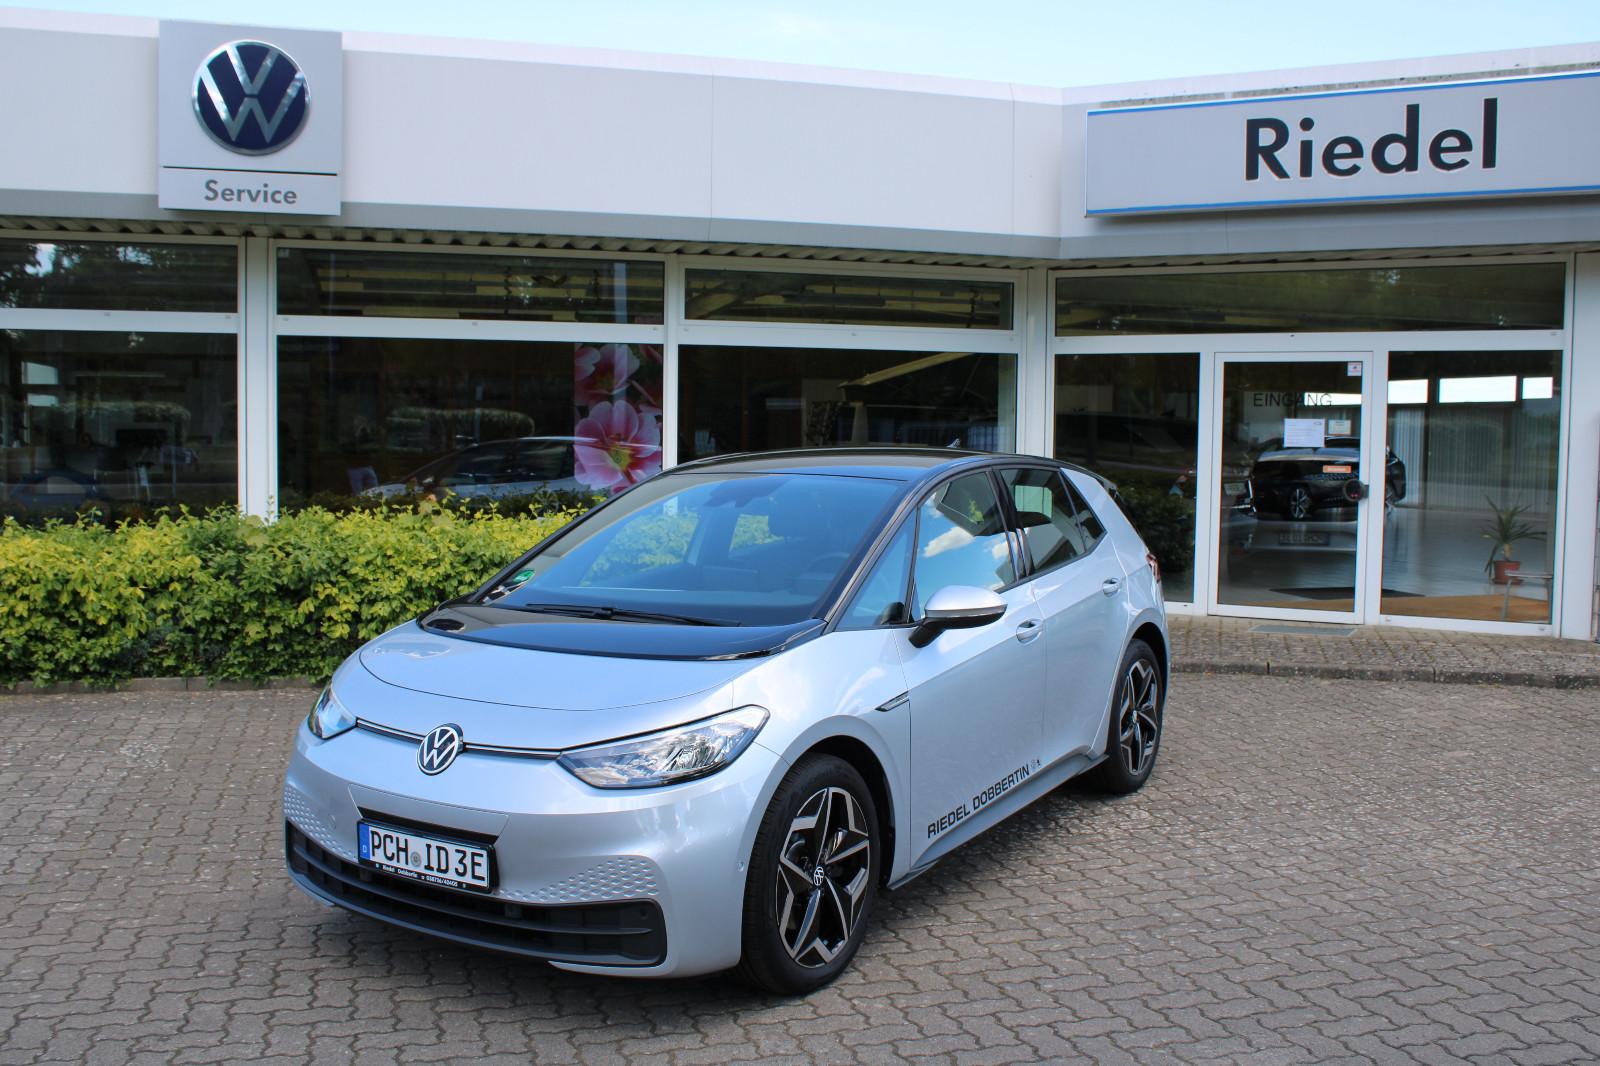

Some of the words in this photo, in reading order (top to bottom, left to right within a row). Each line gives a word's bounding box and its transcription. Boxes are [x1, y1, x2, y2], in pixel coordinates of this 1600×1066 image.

[1245, 97, 1498, 181] Riedel
[204, 179, 298, 204] Service
[1253, 391, 1333, 407] EINGANG
[927, 803, 971, 839] RIEDEL
[972, 764, 1030, 811] DOBBERTIN
[370, 830, 409, 865] PCH
